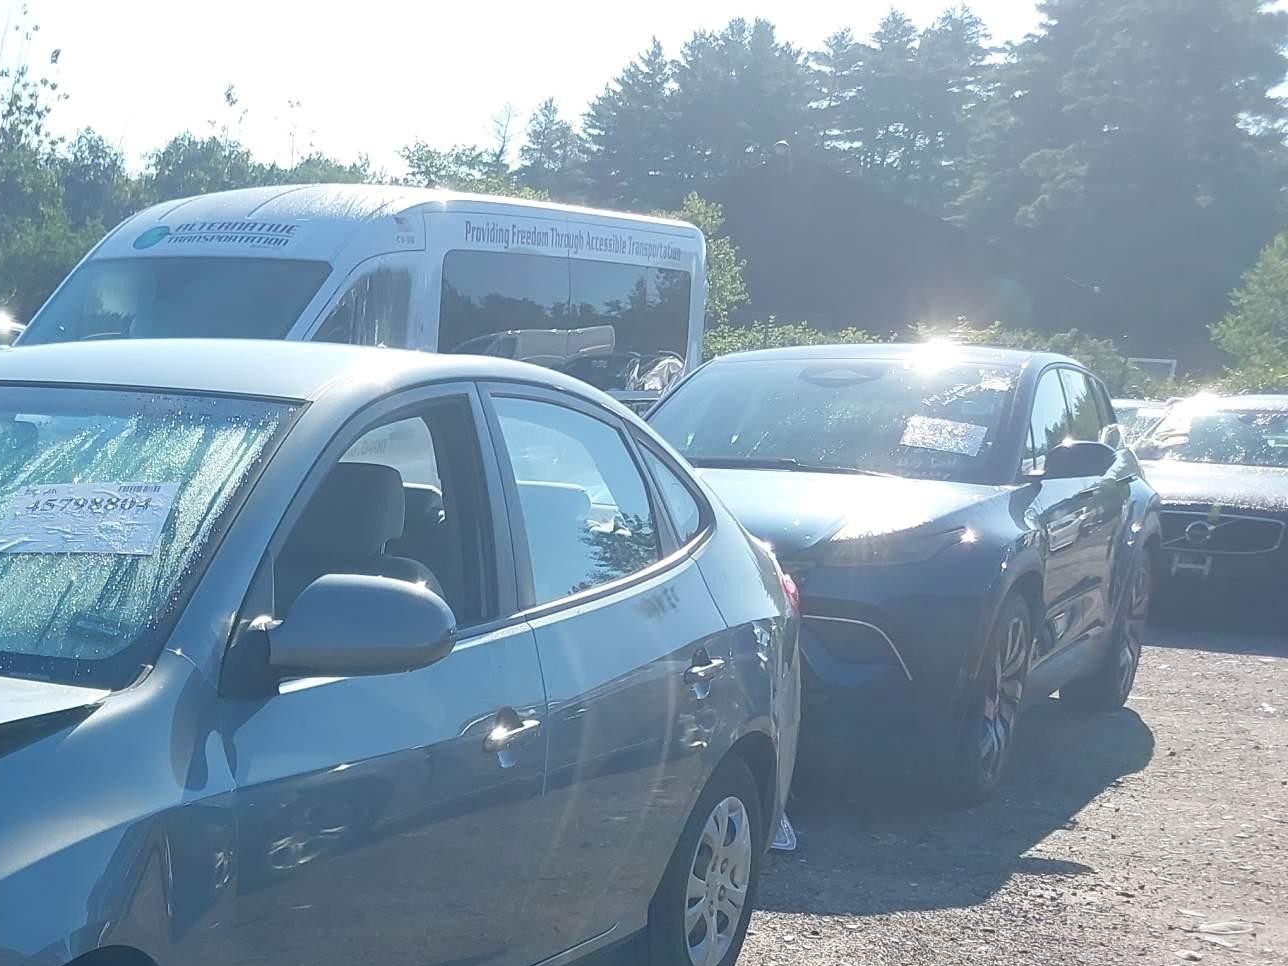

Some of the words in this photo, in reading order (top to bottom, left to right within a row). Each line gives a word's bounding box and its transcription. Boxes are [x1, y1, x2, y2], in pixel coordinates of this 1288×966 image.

[175, 221, 301, 234] ALTERNATIVE
[167, 234, 289, 247] TRANSPORTATION
[465, 221, 510, 248] Providing
[512, 224, 549, 247] Freedom
[550, 227, 584, 254] Through
[586, 231, 627, 254] Accessible
[628, 236, 681, 262] Transportation
[26, 496, 153, 513] 45798804
